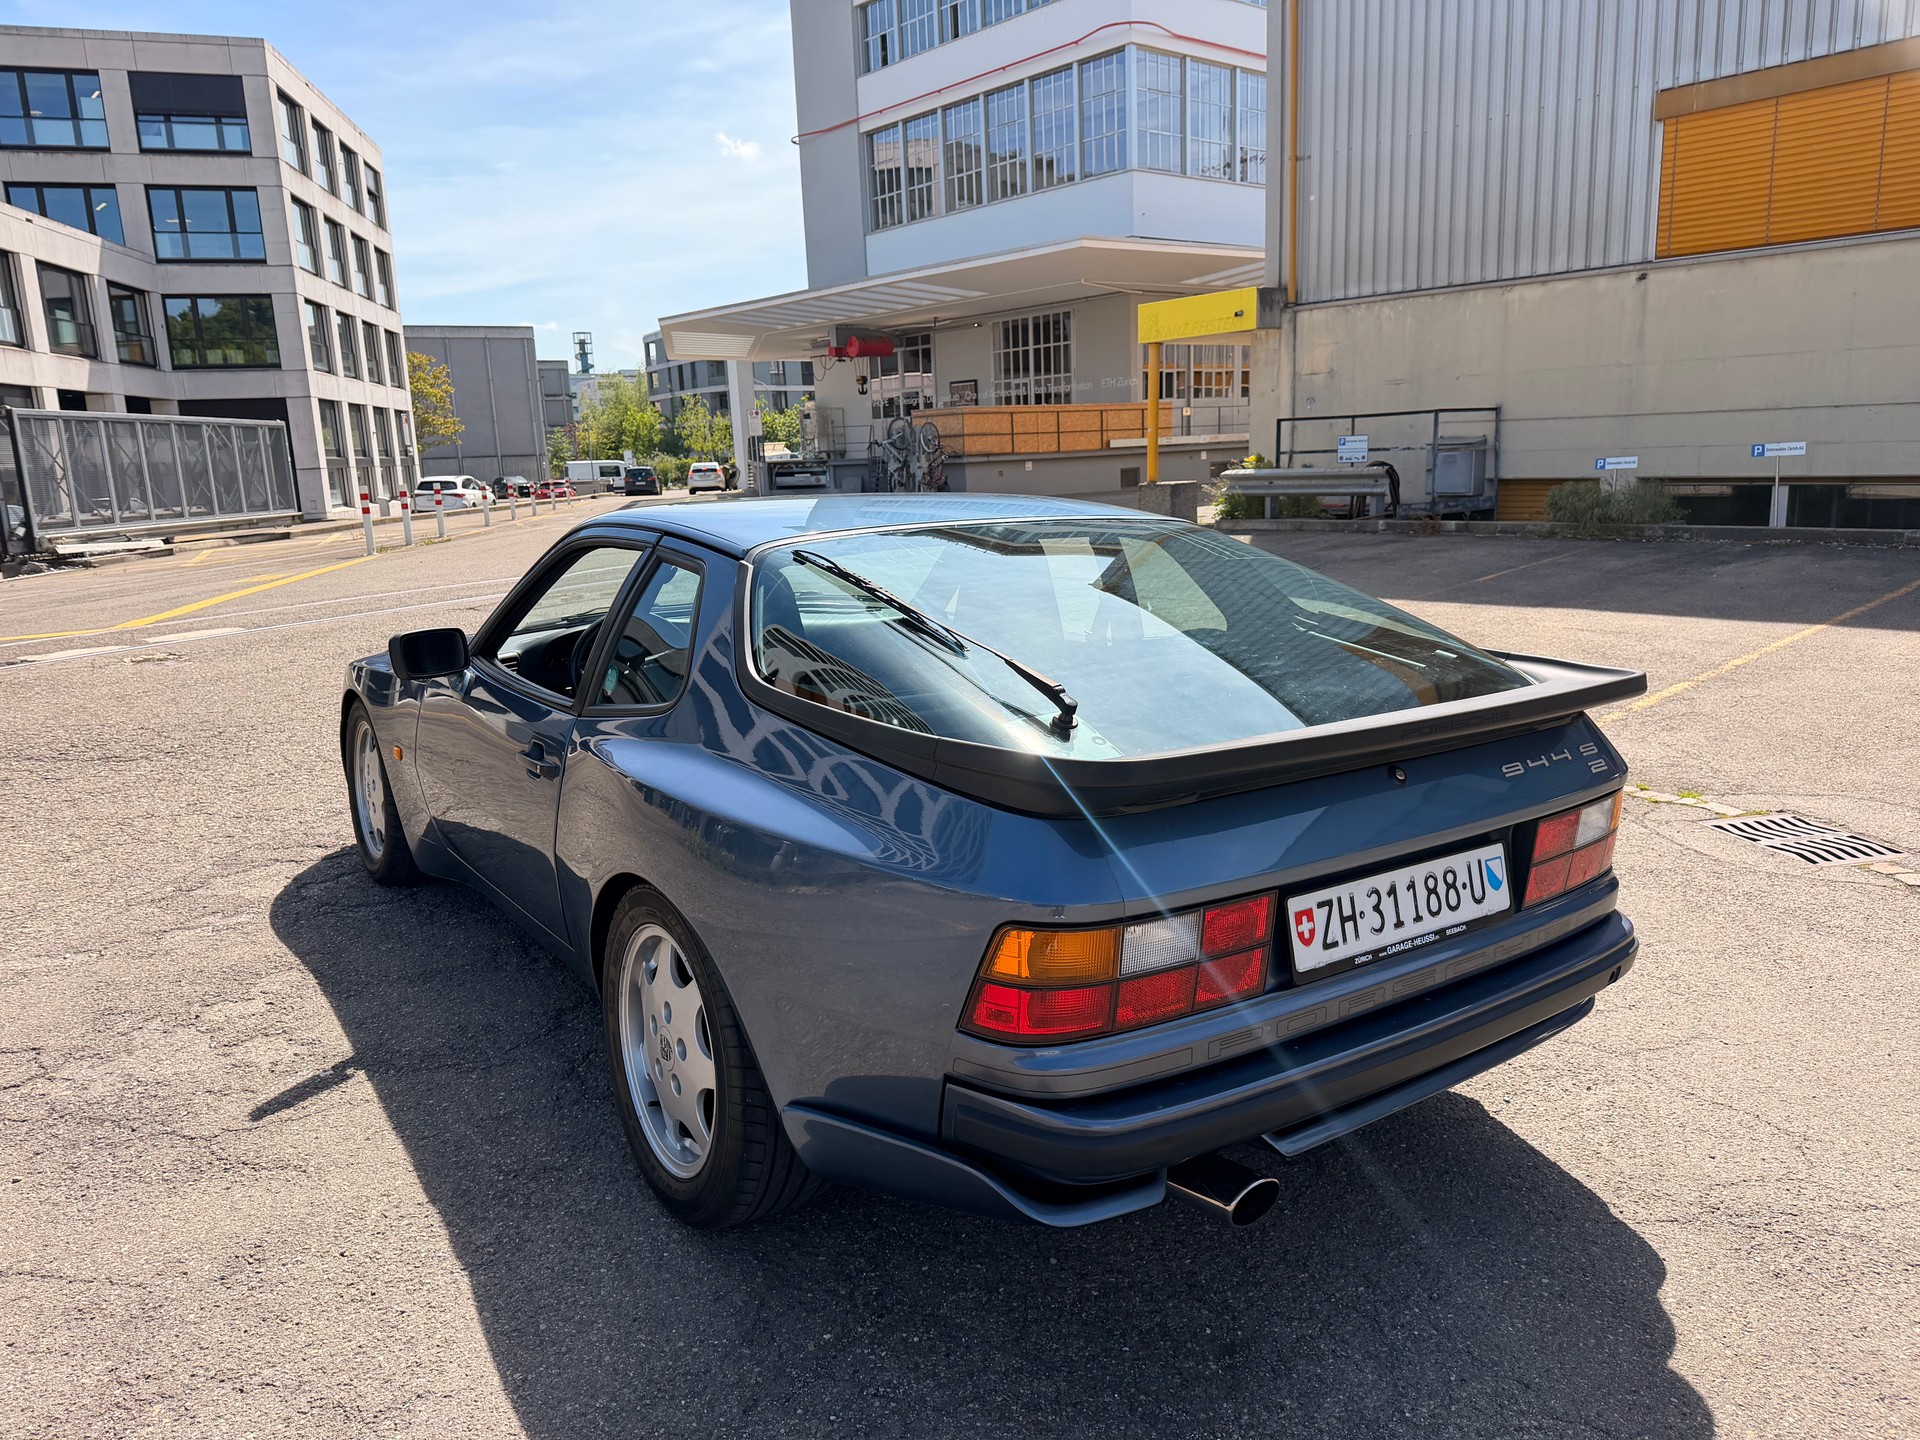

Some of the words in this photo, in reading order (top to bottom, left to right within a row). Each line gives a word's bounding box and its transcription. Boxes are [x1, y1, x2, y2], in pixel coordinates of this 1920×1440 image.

[1192, 316, 1239, 334] PFISTER
[1101, 378, 1116, 388] ETH
[1501, 748, 1572, 778] 944
[1354, 953, 1373, 965] ZÜRICH
[1445, 924, 1467, 936] SEEBACH
[1208, 918, 1572, 1060] PORSCHE
